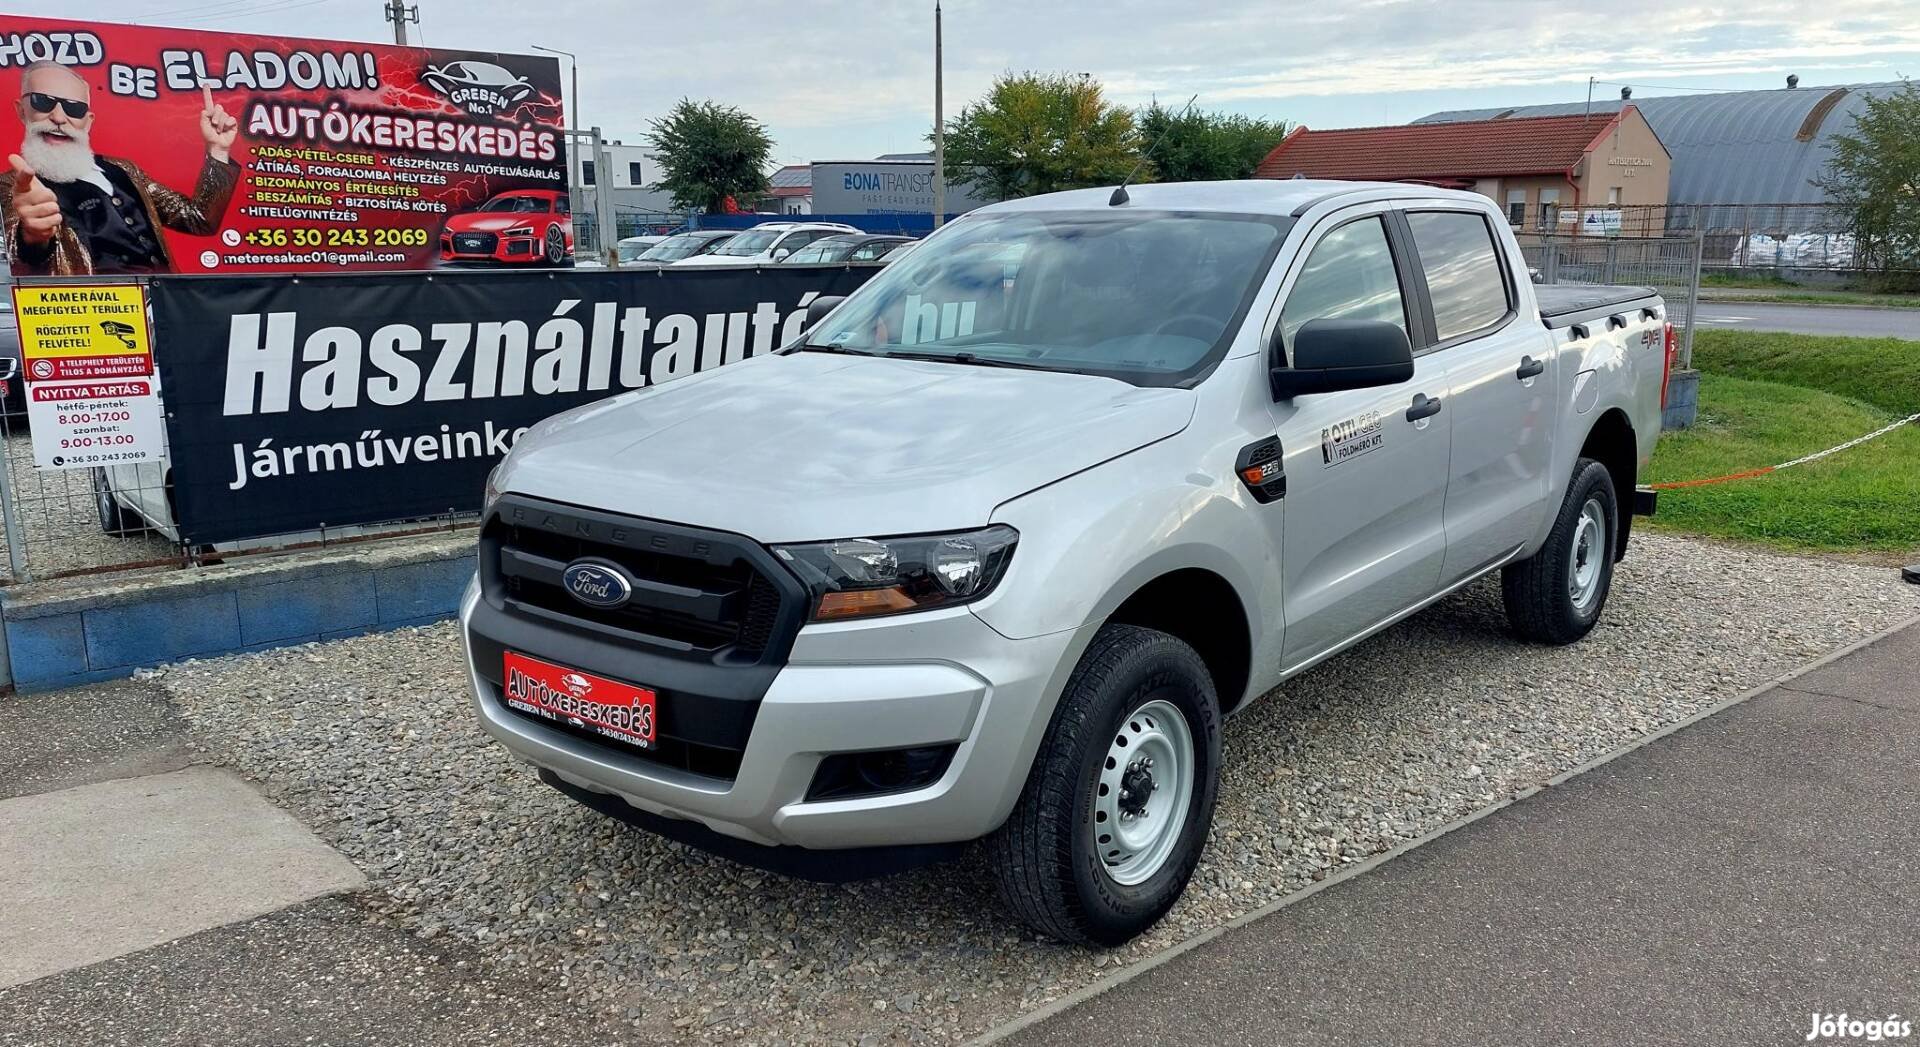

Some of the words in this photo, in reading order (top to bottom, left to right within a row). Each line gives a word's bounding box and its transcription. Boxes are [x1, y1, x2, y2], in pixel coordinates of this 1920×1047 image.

[0, 33, 102, 66] HOZD
[111, 64, 157, 98] BE
[162, 51, 378, 90] ELADOM!
[451, 88, 508, 109] GREBEN
[468, 102, 493, 114] No.1
[250, 103, 556, 161] AUTÓKERESKEDÉS
[258, 147, 374, 165] ADÁS-VÉTEL-CSERE
[389, 157, 460, 172] KÉSZPÉNZES
[464, 163, 561, 180] AUTÓFELVÁSÁRLÁS
[256, 160, 304, 175] ÁTÍRÁS,
[308, 165, 391, 181] FORGALOMBA
[394, 171, 447, 185] HELYEZÉS
[255, 175, 340, 192] BIZOMÁNYOS
[346, 180, 419, 197] ÉRTÉKESÍTÉS
[256, 190, 332, 206] BESZÁMÍTÁS
[345, 196, 410, 211] BIZTOSÍTÁS
[412, 200, 447, 213] KÖTÉS
[249, 206, 358, 222] HITELÜGYINTÉZÉS
[245, 229, 288, 247] +36
[292, 229, 322, 247] 30
[327, 229, 369, 246] 243
[374, 229, 428, 246] 2069
[40, 291, 119, 302] KAMERÁVAL
[23, 306, 87, 316] MEGFIGYELT
[93, 304, 139, 314] TERÜLET!
[36, 325, 90, 336] RÖGZÍTETT
[39, 338, 91, 348] FELVÉTEL!
[67, 359, 104, 367] TELEPHELY
[61, 368, 84, 376] TILOS
[39, 387, 89, 399] NYITVA
[91, 382, 144, 395] TARTÁS:
[58, 411, 130, 425] 8.00-17.00
[73, 425, 120, 435] szombat:
[60, 435, 134, 449] 9.00-13.00
[66, 456, 84, 464] +36
[86, 455, 99, 463] 30
[102, 453, 120, 462] 243
[122, 451, 146, 460] 2069
[513, 508, 712, 558] RANGER
[573, 570, 610, 597] Ford
[508, 667, 652, 737] AUTÓKERESKEDÉS
[508, 699, 539, 715] GREBEN
[540, 708, 556, 720] No.1
